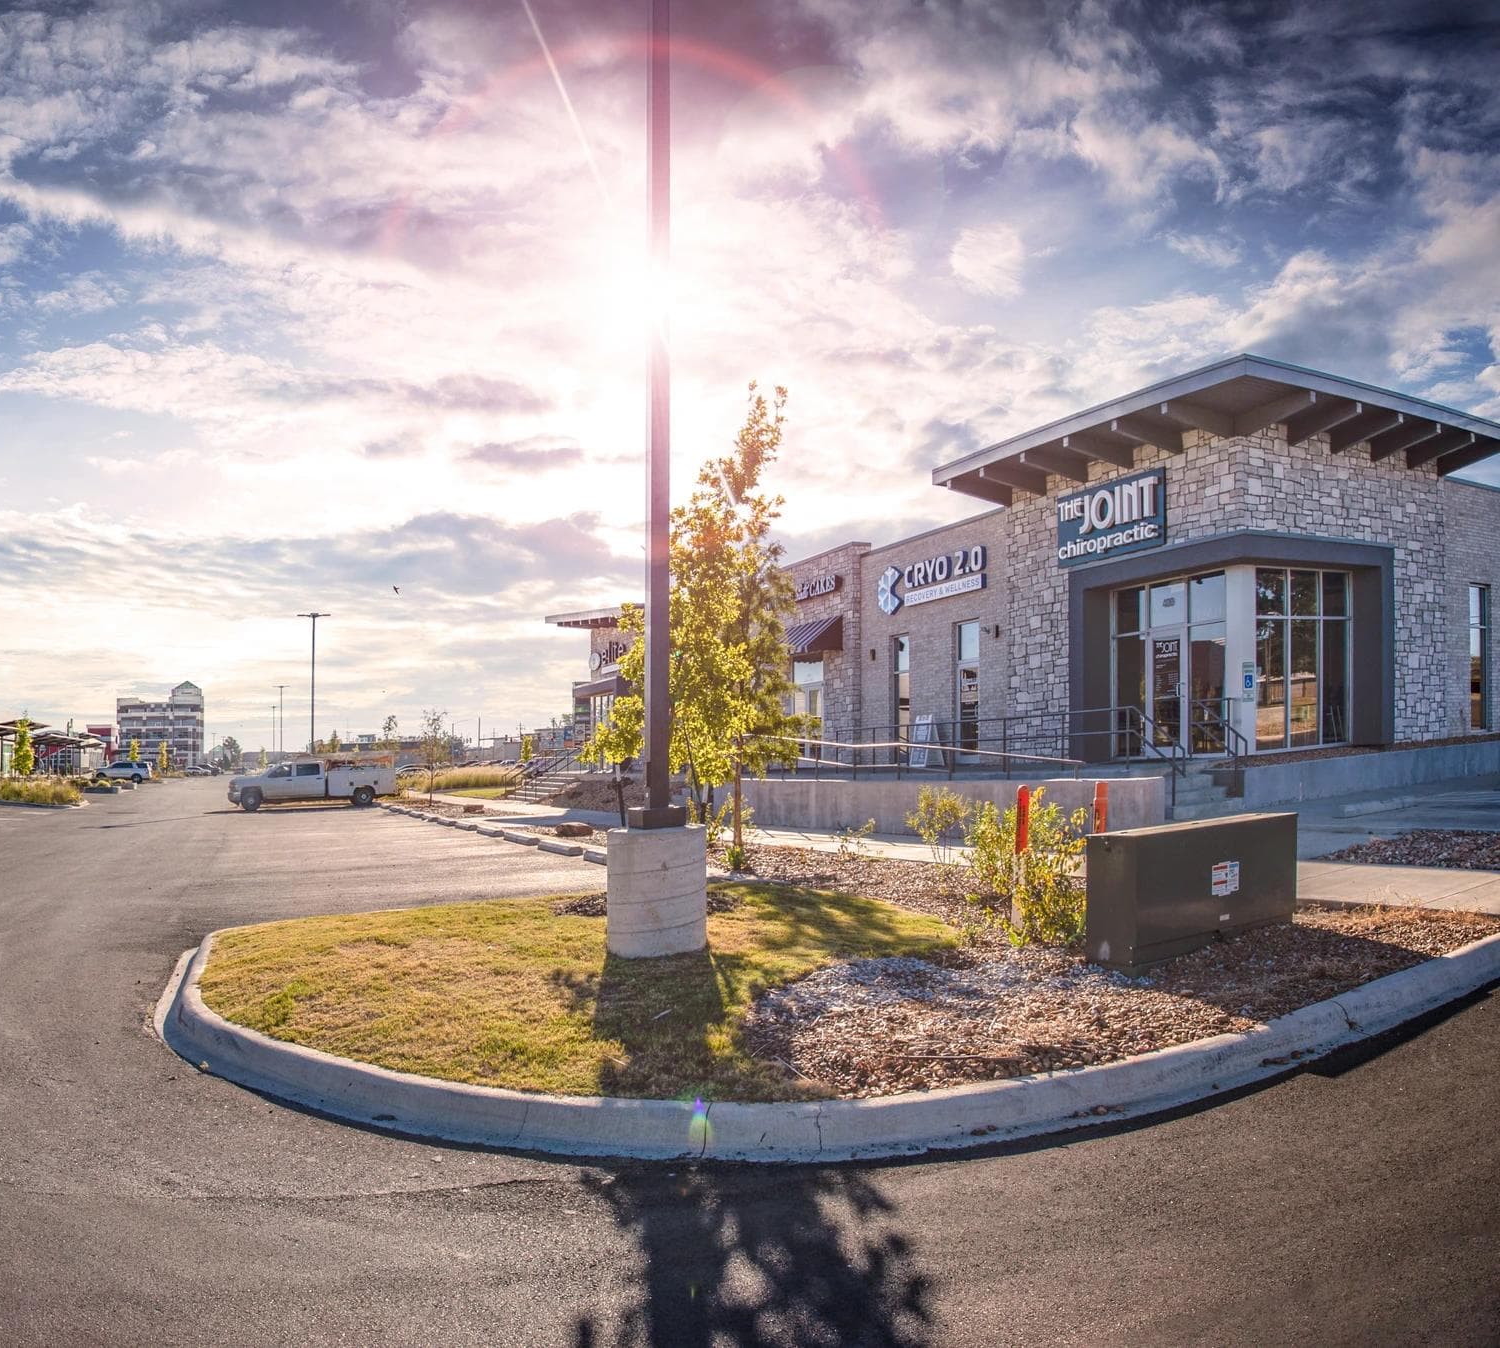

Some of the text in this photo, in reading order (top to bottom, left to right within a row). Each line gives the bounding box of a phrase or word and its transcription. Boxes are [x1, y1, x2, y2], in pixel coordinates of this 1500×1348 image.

[1058, 476, 1158, 534] THE JOINT
[1058, 522, 1158, 560] chiropractic
[904, 545, 984, 589] CRYO 2.0
[905, 589, 938, 605] RECOVERY
[945, 578, 980, 593] WELLNESS
